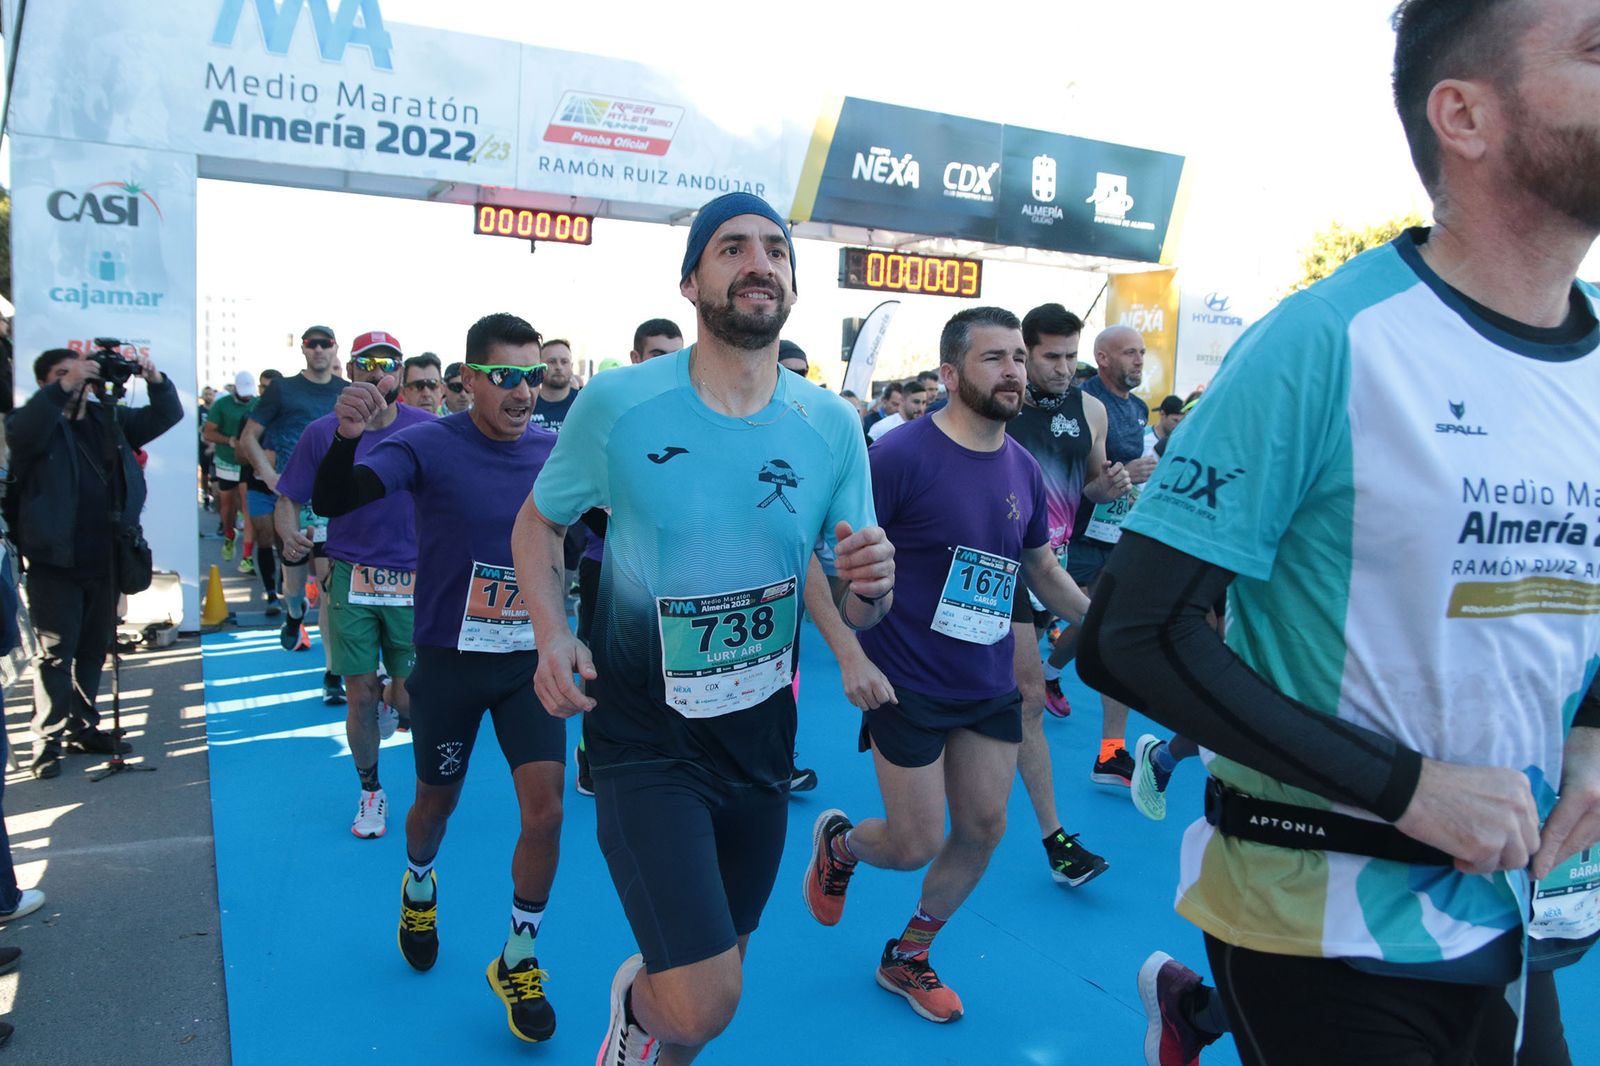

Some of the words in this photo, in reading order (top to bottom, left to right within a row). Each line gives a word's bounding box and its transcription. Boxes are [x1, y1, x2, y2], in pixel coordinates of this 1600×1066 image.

[205, 62, 318, 103] Medio
[337, 81, 479, 125] Maratón
[203, 98, 366, 150] Almería
[571, 131, 611, 147] Prueba
[614, 137, 649, 151] Oficial
[539, 156, 614, 178] RAMÓN
[624, 166, 668, 186] RUIZ
[677, 173, 765, 197] ANDÚJAR
[943, 162, 999, 195] CDX
[46, 188, 140, 227] CASI
[1021, 204, 1063, 220] ALMERÍA
[49, 282, 164, 310] cajamar
[1192, 312, 1243, 326] HYUNDAI
[1435, 423, 1488, 435] SPALL
[1462, 477, 1554, 505] Medio
[1458, 511, 1588, 545] Almería
[360, 567, 412, 587] 1680
[1451, 557, 1527, 577] RAMÓN
[1530, 559, 1577, 576] RUIZ
[482, 581, 525, 608] 17
[960, 564, 1012, 602] 1676
[701, 602, 730, 613] Almería
[723, 593, 750, 603] Maratón
[973, 594, 998, 607] CARLOS
[690, 605, 775, 654] 738
[707, 649, 737, 663] LURY
[741, 644, 762, 657] ARB
[1249, 815, 1326, 836] APTONIA
